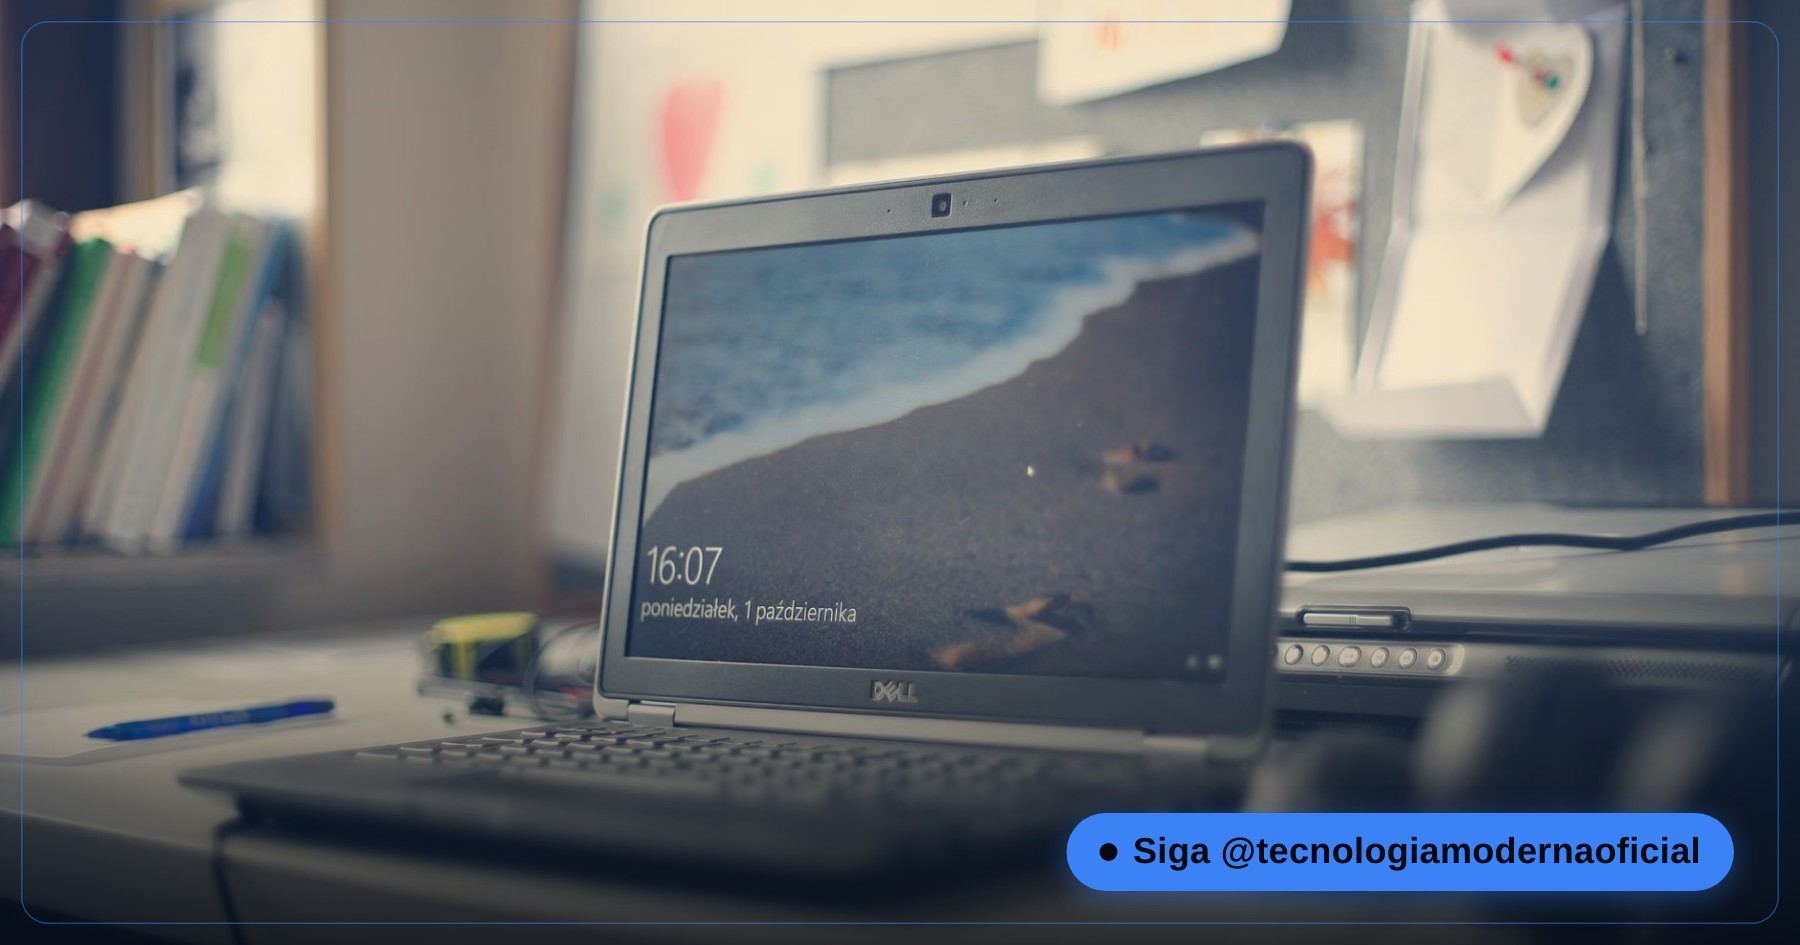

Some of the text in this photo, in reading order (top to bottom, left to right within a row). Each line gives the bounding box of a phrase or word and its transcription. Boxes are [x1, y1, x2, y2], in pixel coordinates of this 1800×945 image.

[647, 545, 724, 586] 16:07
[640, 597, 858, 626] poniedziałek, 1 października
[872, 680, 919, 703] DELL
